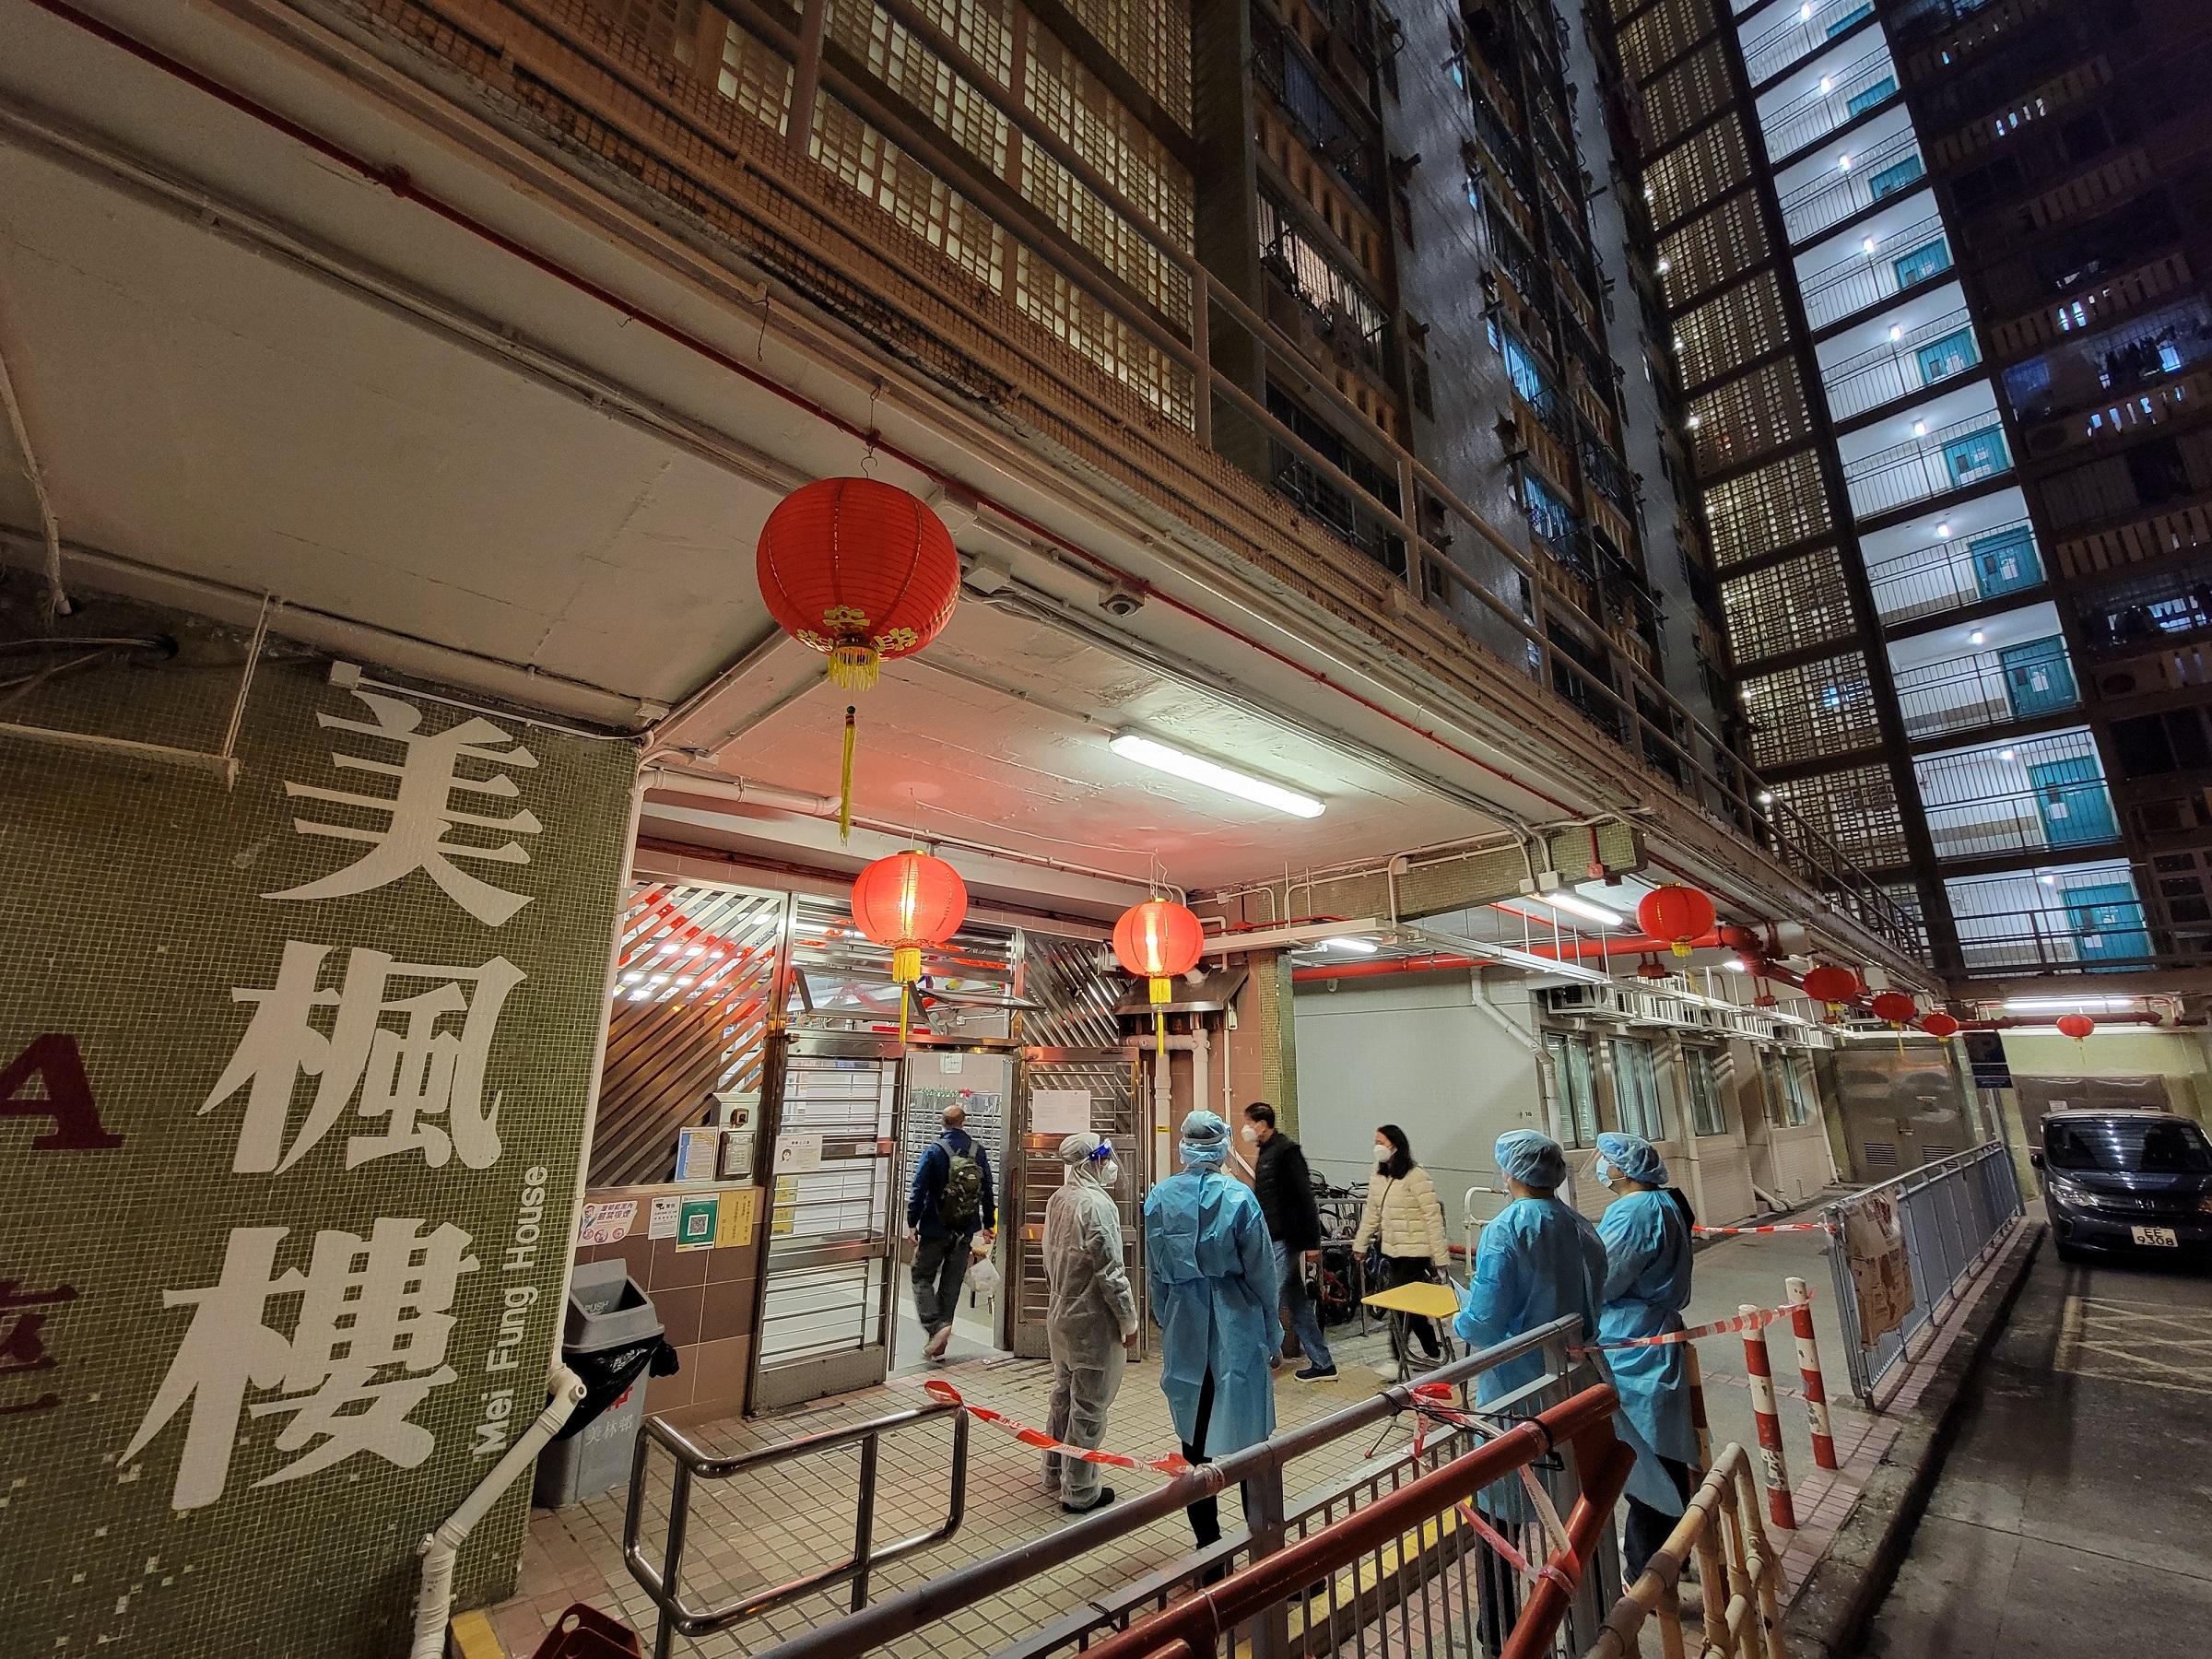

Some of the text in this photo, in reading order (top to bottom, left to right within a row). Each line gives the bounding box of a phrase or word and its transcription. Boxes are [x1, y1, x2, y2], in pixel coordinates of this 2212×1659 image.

[0, 1032, 124, 1150] A
[117, 689, 543, 1510] 美楓樓
[2136, 1236, 2175, 1246] 9308
[2144, 1228, 2163, 1238] EE
[472, 1166, 547, 1455] Mei Fung House
